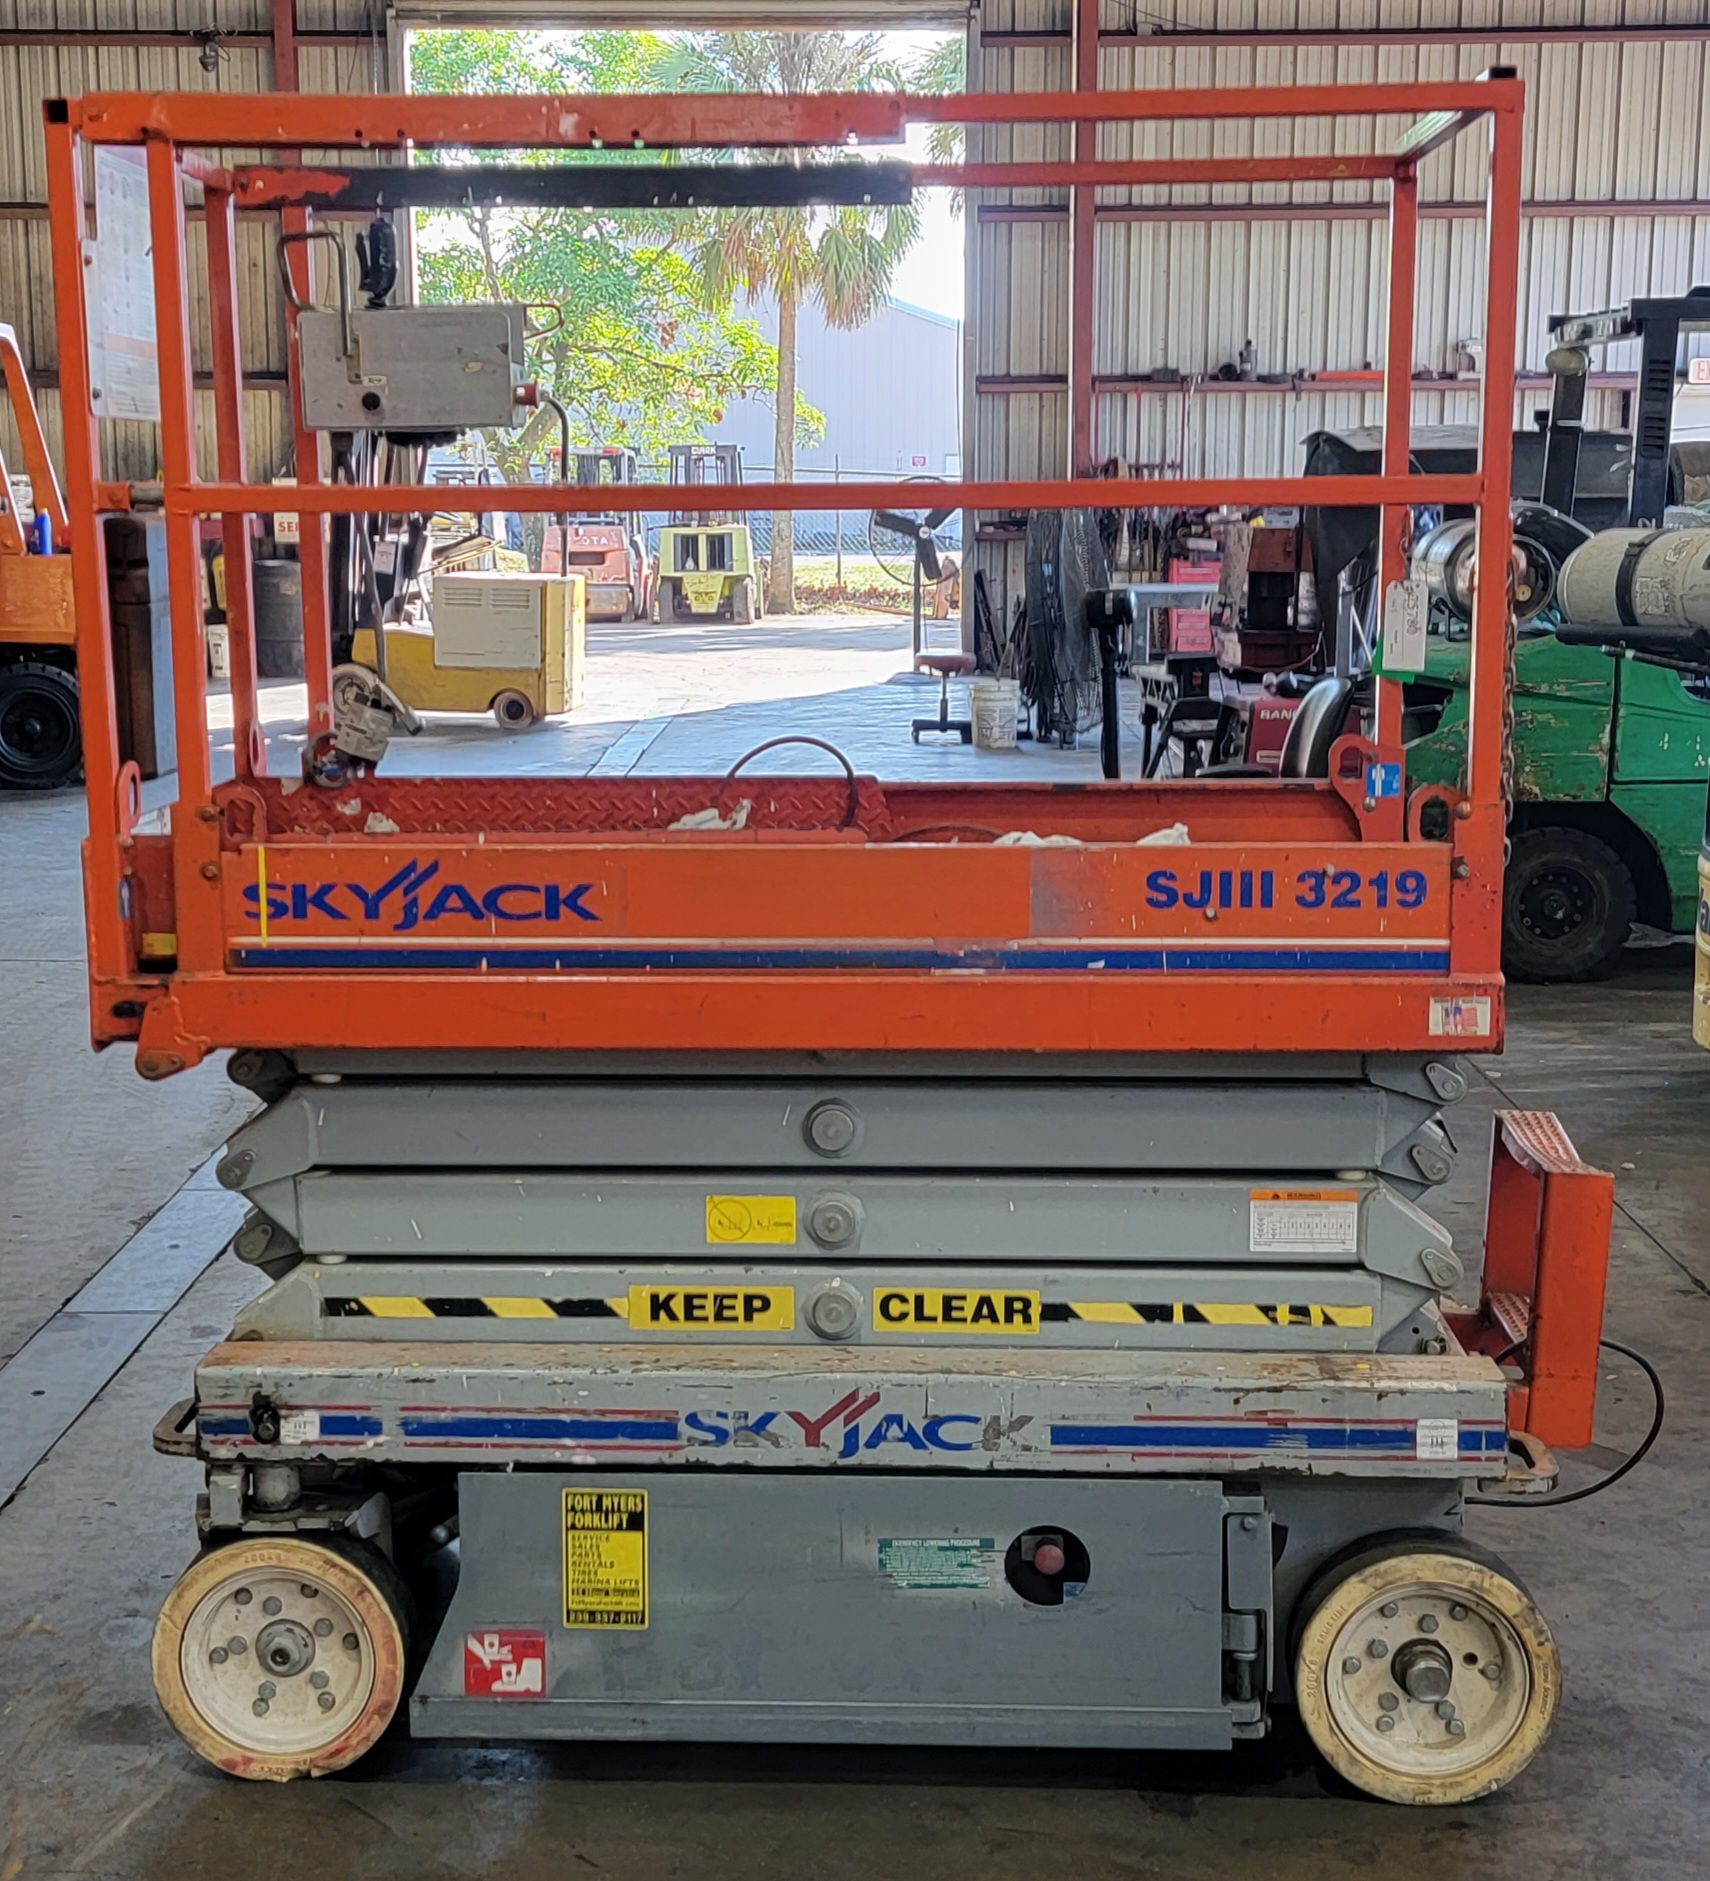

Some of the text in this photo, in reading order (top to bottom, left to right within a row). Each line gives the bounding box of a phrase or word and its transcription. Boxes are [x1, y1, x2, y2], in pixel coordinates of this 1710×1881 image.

[242, 859, 603, 931] SKYJACK
[1295, 870, 1428, 909] 3219
[649, 1292, 773, 1324] KEEP
[878, 1294, 1033, 1326] CLEAR
[683, 1386, 1036, 1460] SKYJACK
[567, 1493, 643, 1512] FORT MYERS
[567, 1511, 629, 1530] FORKLIFT
